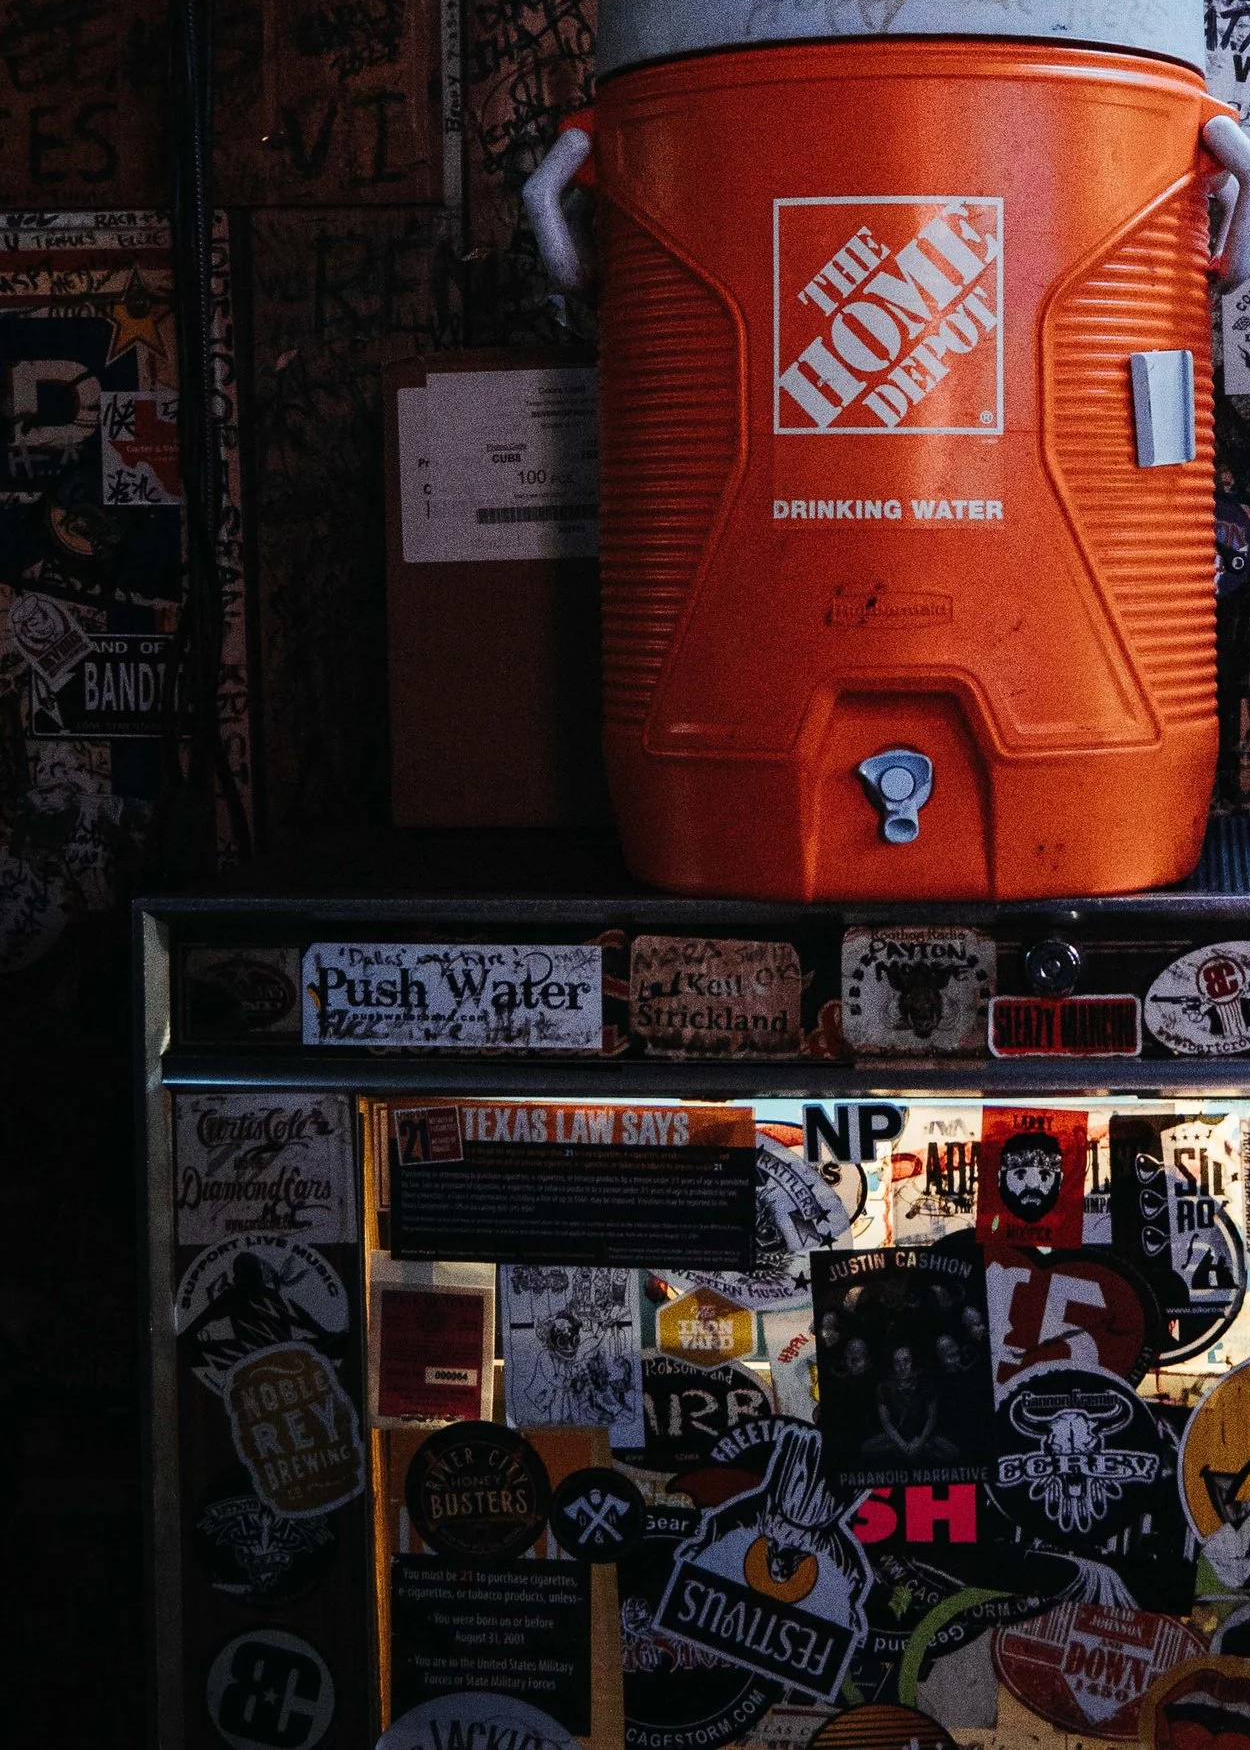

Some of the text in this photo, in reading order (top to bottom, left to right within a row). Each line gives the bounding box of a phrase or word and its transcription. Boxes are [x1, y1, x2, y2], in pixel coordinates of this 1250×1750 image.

[797, 224, 891, 319] THE
[779, 200, 1000, 430] HOME
[860, 285, 1002, 430] DEPOT
[773, 498, 1003, 520] DRINKING WATER
[316, 964, 592, 1012] Push Water
[636, 1002, 790, 1034] Strickland
[461, 1106, 690, 1148] TEXAS LAW SAYS
[802, 1103, 903, 1163] NP
[757, 1153, 822, 1218] RATTLERS
[180, 1233, 342, 1311] SUPPORT LIVE MUSIC
[828, 1250, 974, 1283] JUSTIN CASHION
[678, 1319, 734, 1335] IRON
[240, 1370, 330, 1417] NOBLE
[250, 1398, 339, 1458] REY
[264, 1446, 352, 1492] BREWING
[424, 1447, 528, 1492] RIVER CITY
[839, 1464, 990, 1487] PARANOID NARRATIVE
[430, 1489, 529, 1520] BUSTERS
[402, 1568, 578, 1588] You must be 21 to purchase cigarettes,
[433, 1614, 554, 1628] You were born on or before
[454, 1632, 487, 1645] August
[503, 1633, 525, 1645] 2001
[625, 1688, 765, 1750] CAGESTORM.COM
